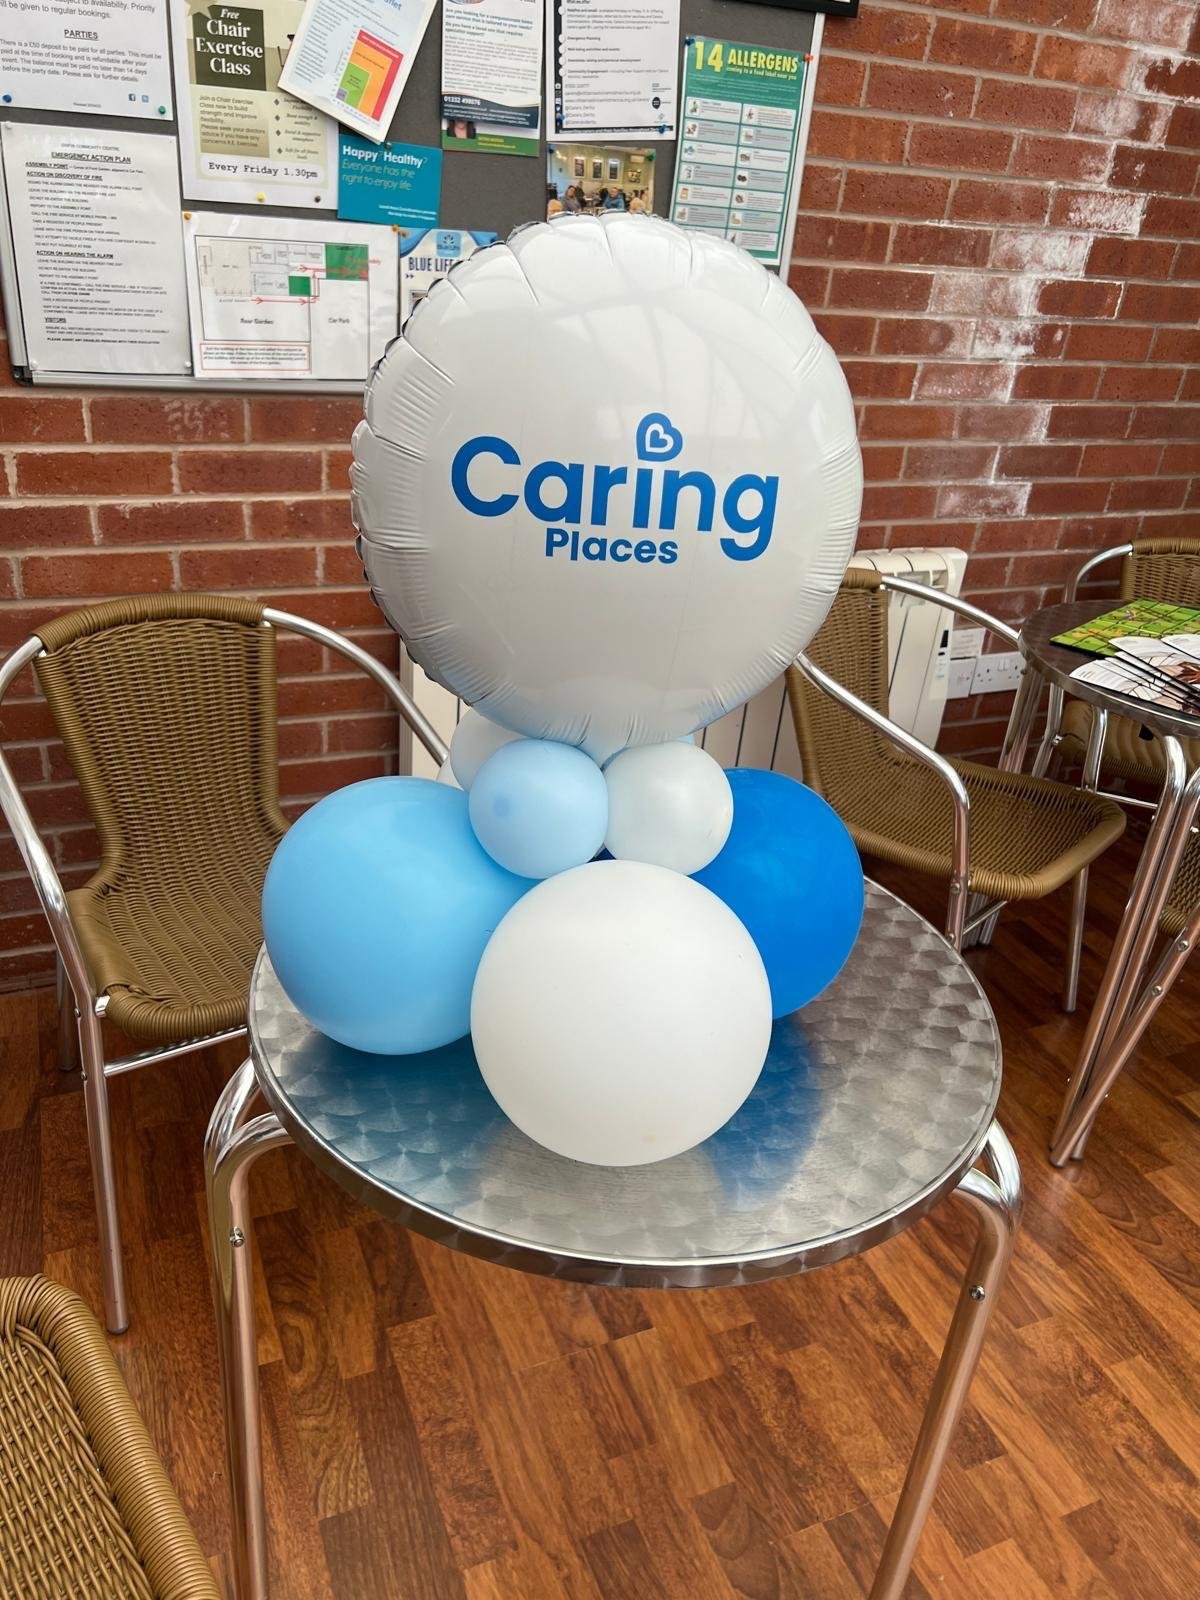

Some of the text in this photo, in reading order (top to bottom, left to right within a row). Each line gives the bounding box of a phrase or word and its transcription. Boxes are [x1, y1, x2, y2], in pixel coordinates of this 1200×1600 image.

[20, 3, 40, 11] given
[51, 6, 76, 15] regular
[78, 8, 112, 19] bookings.
[131, 3, 155, 13] Priority
[220, 8, 240, 20] Free
[64, 29, 98, 40] PARTIES
[206, 19, 251, 38] Chair
[195, 37, 264, 59] Exercise
[695, 41, 724, 73] 14
[728, 48, 798, 73] ALLERGENS
[210, 57, 251, 76] Class
[25, 161, 52, 169] ASSEMBLY
[51, 151, 131, 164] EMERGENCY ACTION PLAN
[55, 172, 83, 180] DISCOVERY
[209, 162, 318, 179] Every Friday 1.30pm
[342, 159, 415, 178] Everyone has the
[343, 174, 363, 185] right
[364, 175, 374, 185] to
[374, 178, 398, 190] enjoy
[408, 257, 432, 272] BLUE
[451, 434, 779, 561] Caring
[545, 528, 679, 564] Places
